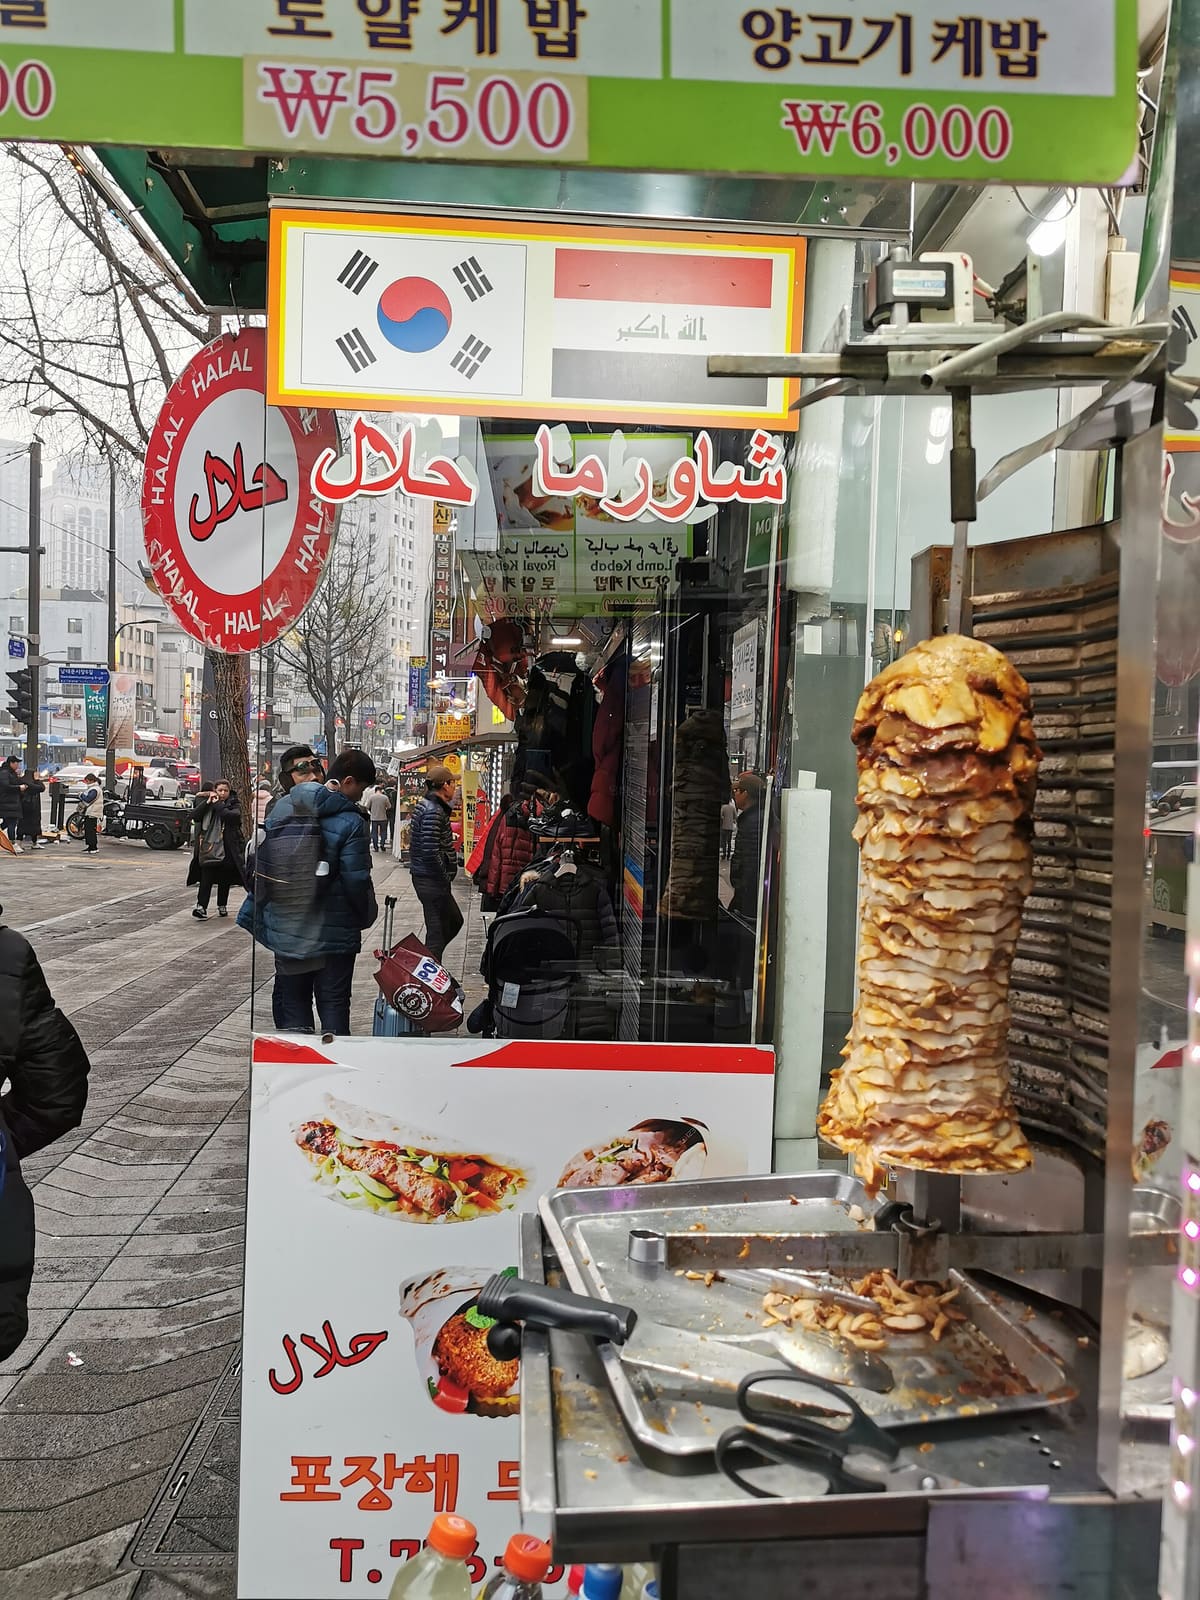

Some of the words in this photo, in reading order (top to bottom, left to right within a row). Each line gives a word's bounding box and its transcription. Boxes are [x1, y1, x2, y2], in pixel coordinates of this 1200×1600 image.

[740, 7, 914, 76] 양고기
[930, 18, 1048, 79] 케밥
[0, 63, 53, 118] 0
[262, 65, 571, 151] ₩5,500
[783, 102, 1011, 163] ₩6,000
[190, 347, 253, 399] HALAL
[150, 415, 185, 505] HALAL
[188, 441, 289, 542] حلال
[311, 415, 477, 505] حلال
[534, 424, 786, 523] شاورما
[294, 492, 326, 575] HALA
[268, 1319, 389, 1395] حلال
[279, 1453, 460, 1512] 포장해
